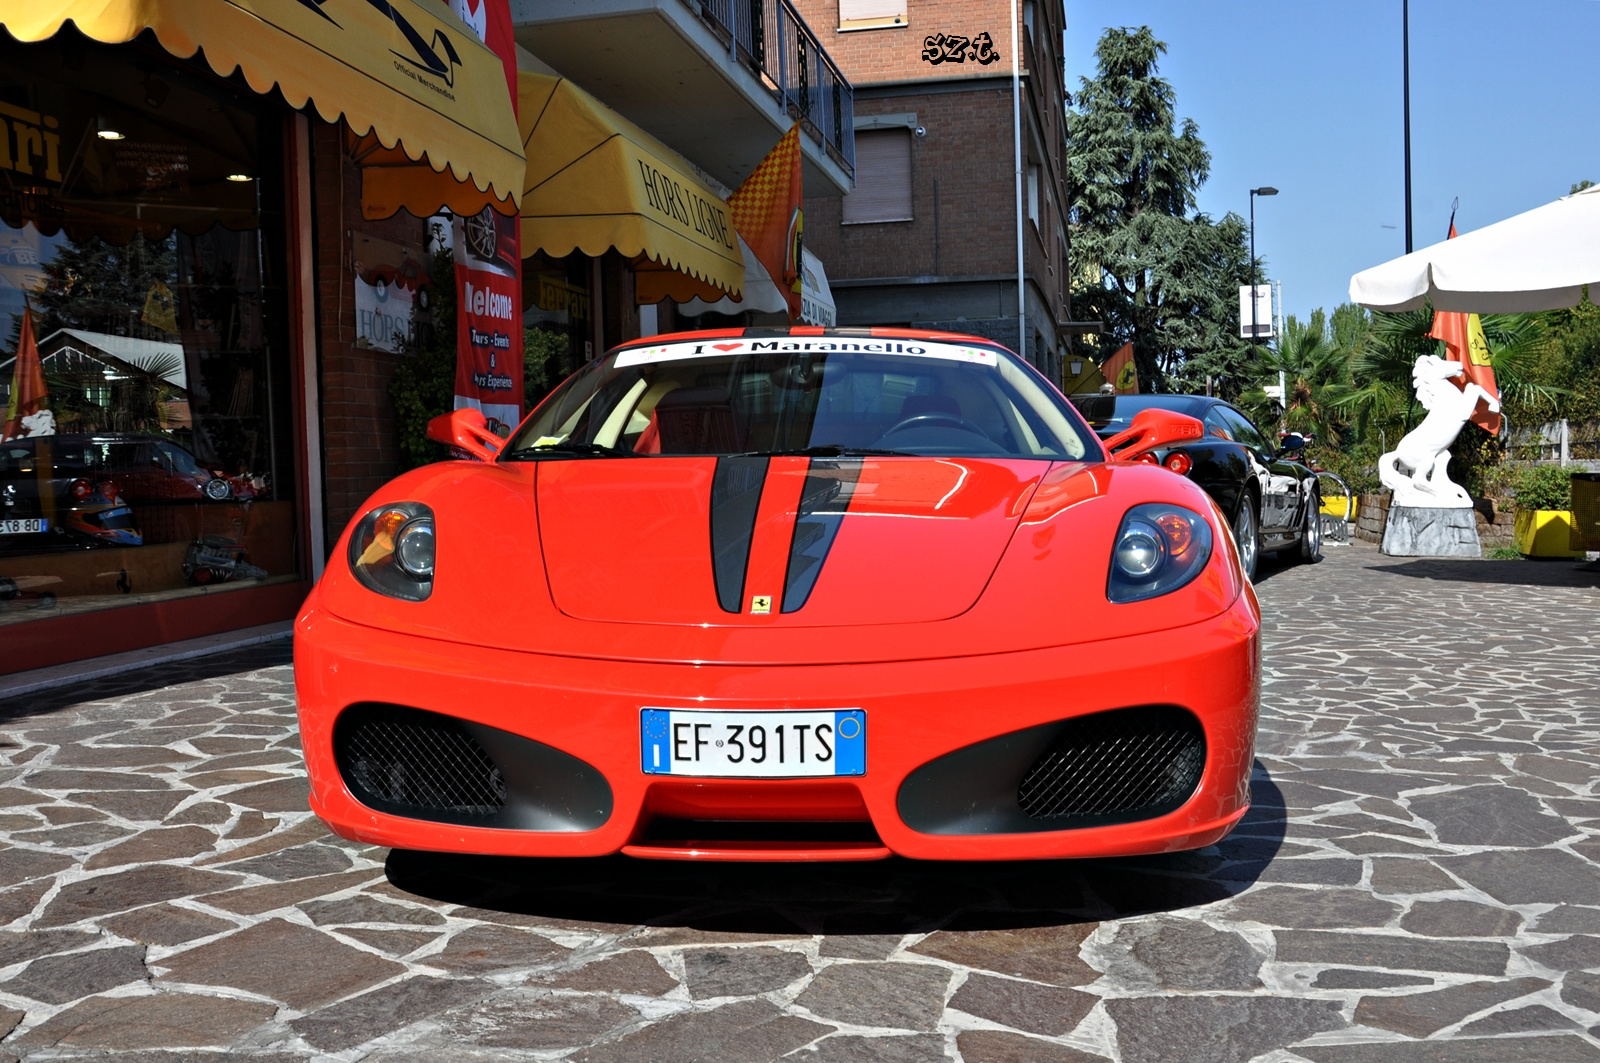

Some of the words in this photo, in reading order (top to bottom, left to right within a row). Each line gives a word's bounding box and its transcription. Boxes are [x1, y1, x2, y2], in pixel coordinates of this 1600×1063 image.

[394, 60, 417, 80] Official
[417, 73, 456, 102] Merchandise
[637, 158, 690, 227] HORS
[684, 188, 734, 250] LIGNE
[360, 309, 404, 344] HORS
[490, 353, 496, 368] &
[691, 344, 707, 356] I
[750, 341, 927, 355] Maranello
[673, 723, 711, 761] EF
[726, 723, 833, 764] 391TS
